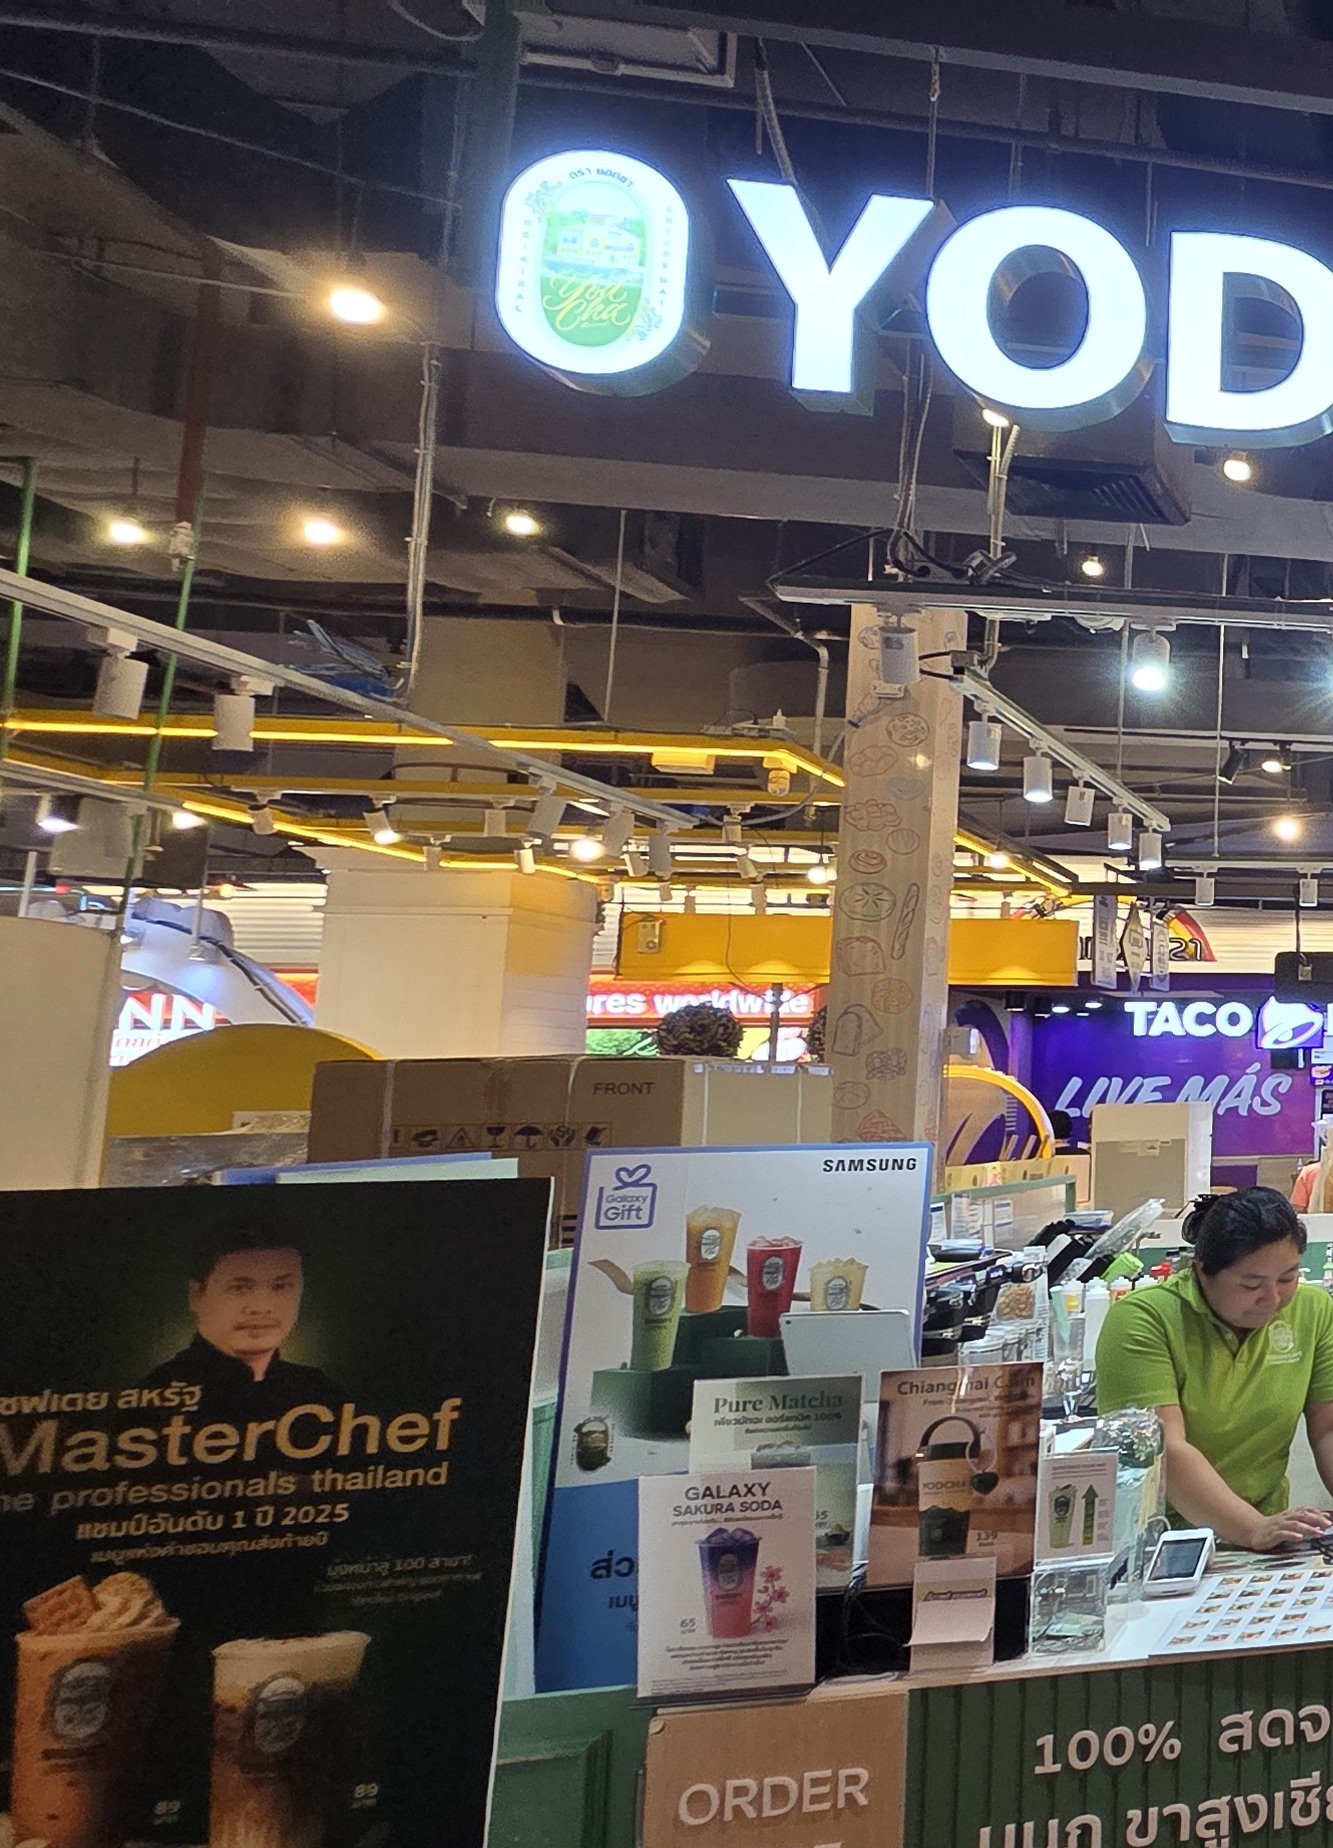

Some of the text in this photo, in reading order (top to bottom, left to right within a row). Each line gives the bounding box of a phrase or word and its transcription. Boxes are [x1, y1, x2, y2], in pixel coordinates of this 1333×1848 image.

[1124, 1001, 1253, 1037] TACO
[592, 1081, 656, 1096] FRONT
[1175, 1061, 1292, 1118] MÁS
[822, 1157, 918, 1173] SAMSUNG
[603, 1205, 645, 1222] Gift
[713, 1390, 843, 1414] Pure Matcha
[0, 1398, 463, 1476] MasterChef
[50, 1469, 298, 1516] professionals
[312, 1461, 450, 1493] thailand
[684, 1481, 771, 1502] GALAXY
[232, 1510, 248, 1529] 1
[256, 1503, 274, 1528] ปี
[280, 1502, 350, 1526] 2025
[672, 1499, 783, 1518] SAKURA SODA
[394, 1557, 426, 1571] 100
[590, 1550, 637, 1580] ส่ว
[1033, 1720, 1182, 1775] 100%
[678, 1766, 871, 1828] ORDER
